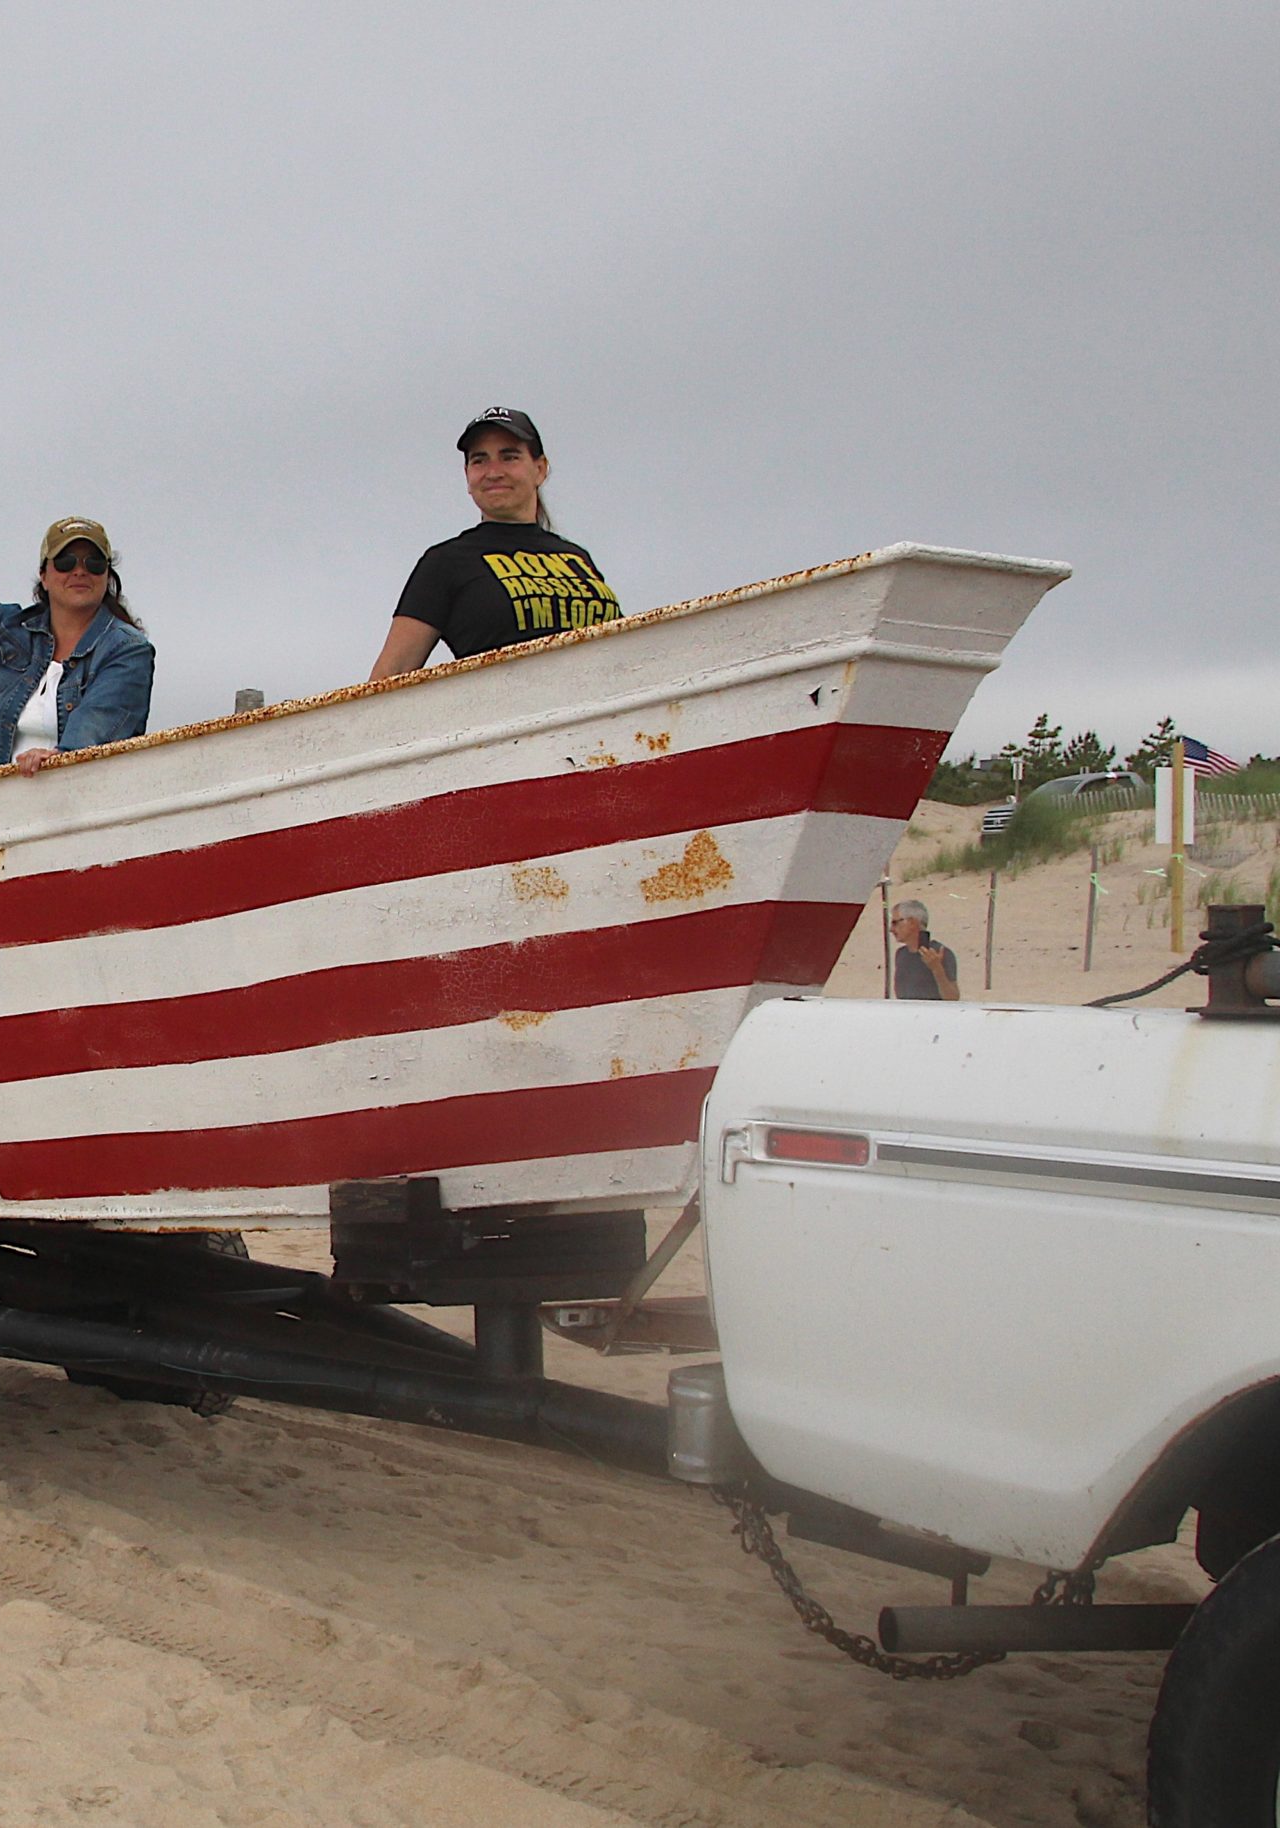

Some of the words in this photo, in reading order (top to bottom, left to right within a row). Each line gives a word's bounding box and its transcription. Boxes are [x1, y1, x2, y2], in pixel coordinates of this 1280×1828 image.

[482, 551, 599, 579] DON'T
[500, 577, 593, 599] HASSLE
[585, 578, 616, 601] M
[513, 597, 554, 631] I'M
